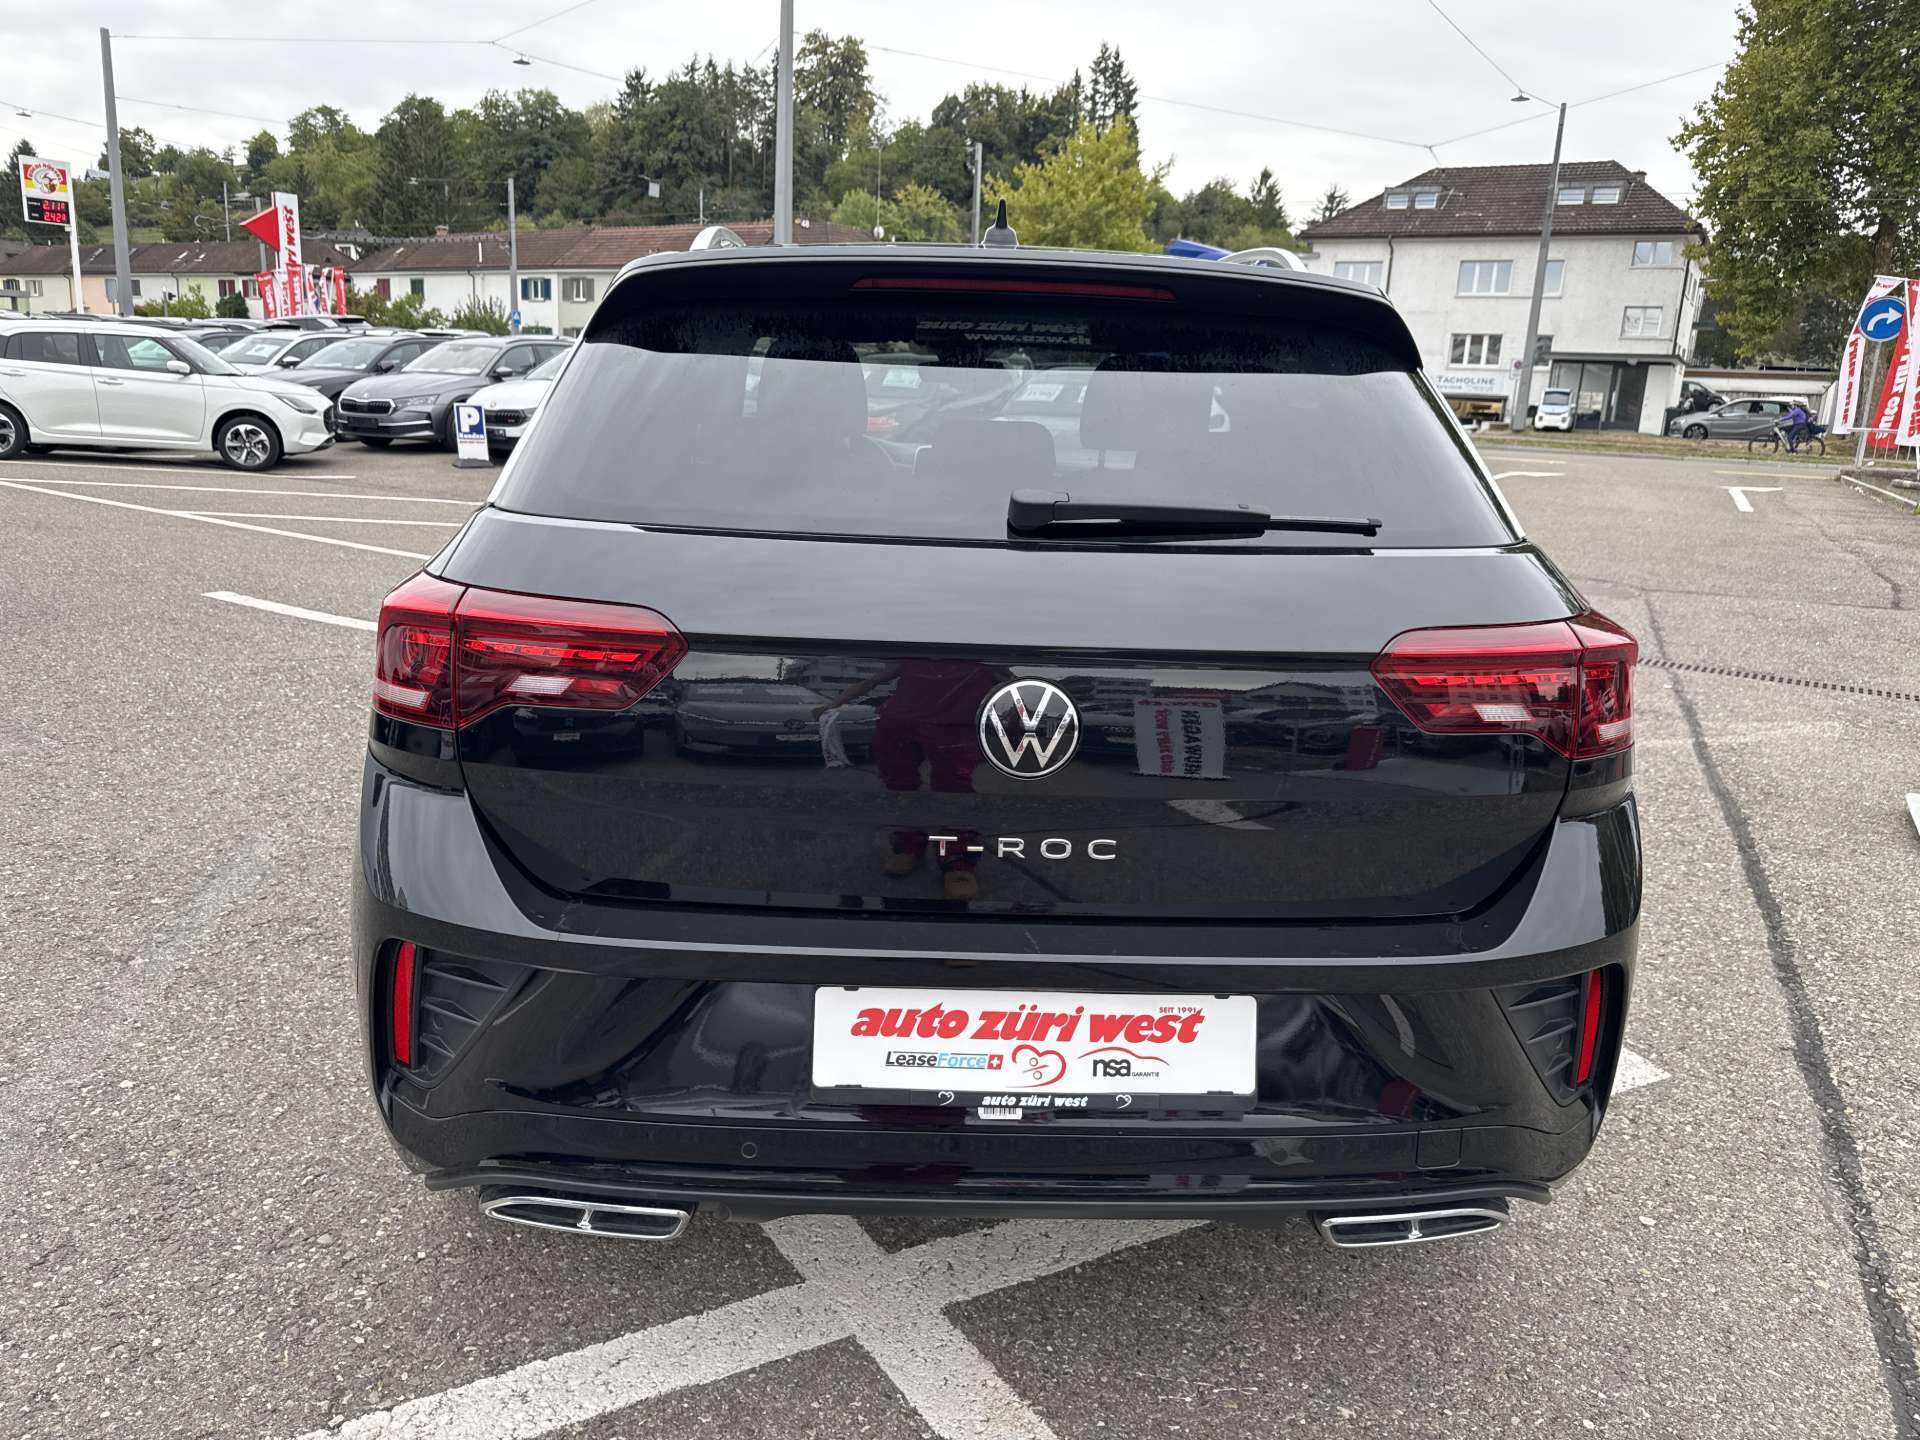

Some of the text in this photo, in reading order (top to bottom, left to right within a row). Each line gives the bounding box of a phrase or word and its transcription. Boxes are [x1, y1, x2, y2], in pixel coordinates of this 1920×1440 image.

[283, 205, 296, 247] west
[964, 333, 1091, 345] www.azw.ch
[1436, 375, 1496, 386] TACHOLINE
[459, 407, 480, 433] P
[928, 835, 1118, 860] T-ROC
[850, 1002, 1206, 1043] auto züri west
[885, 1051, 987, 1069] LeaseForce
[1092, 1059, 1131, 1077] nsa
[982, 1095, 1089, 1107] auto züri west
